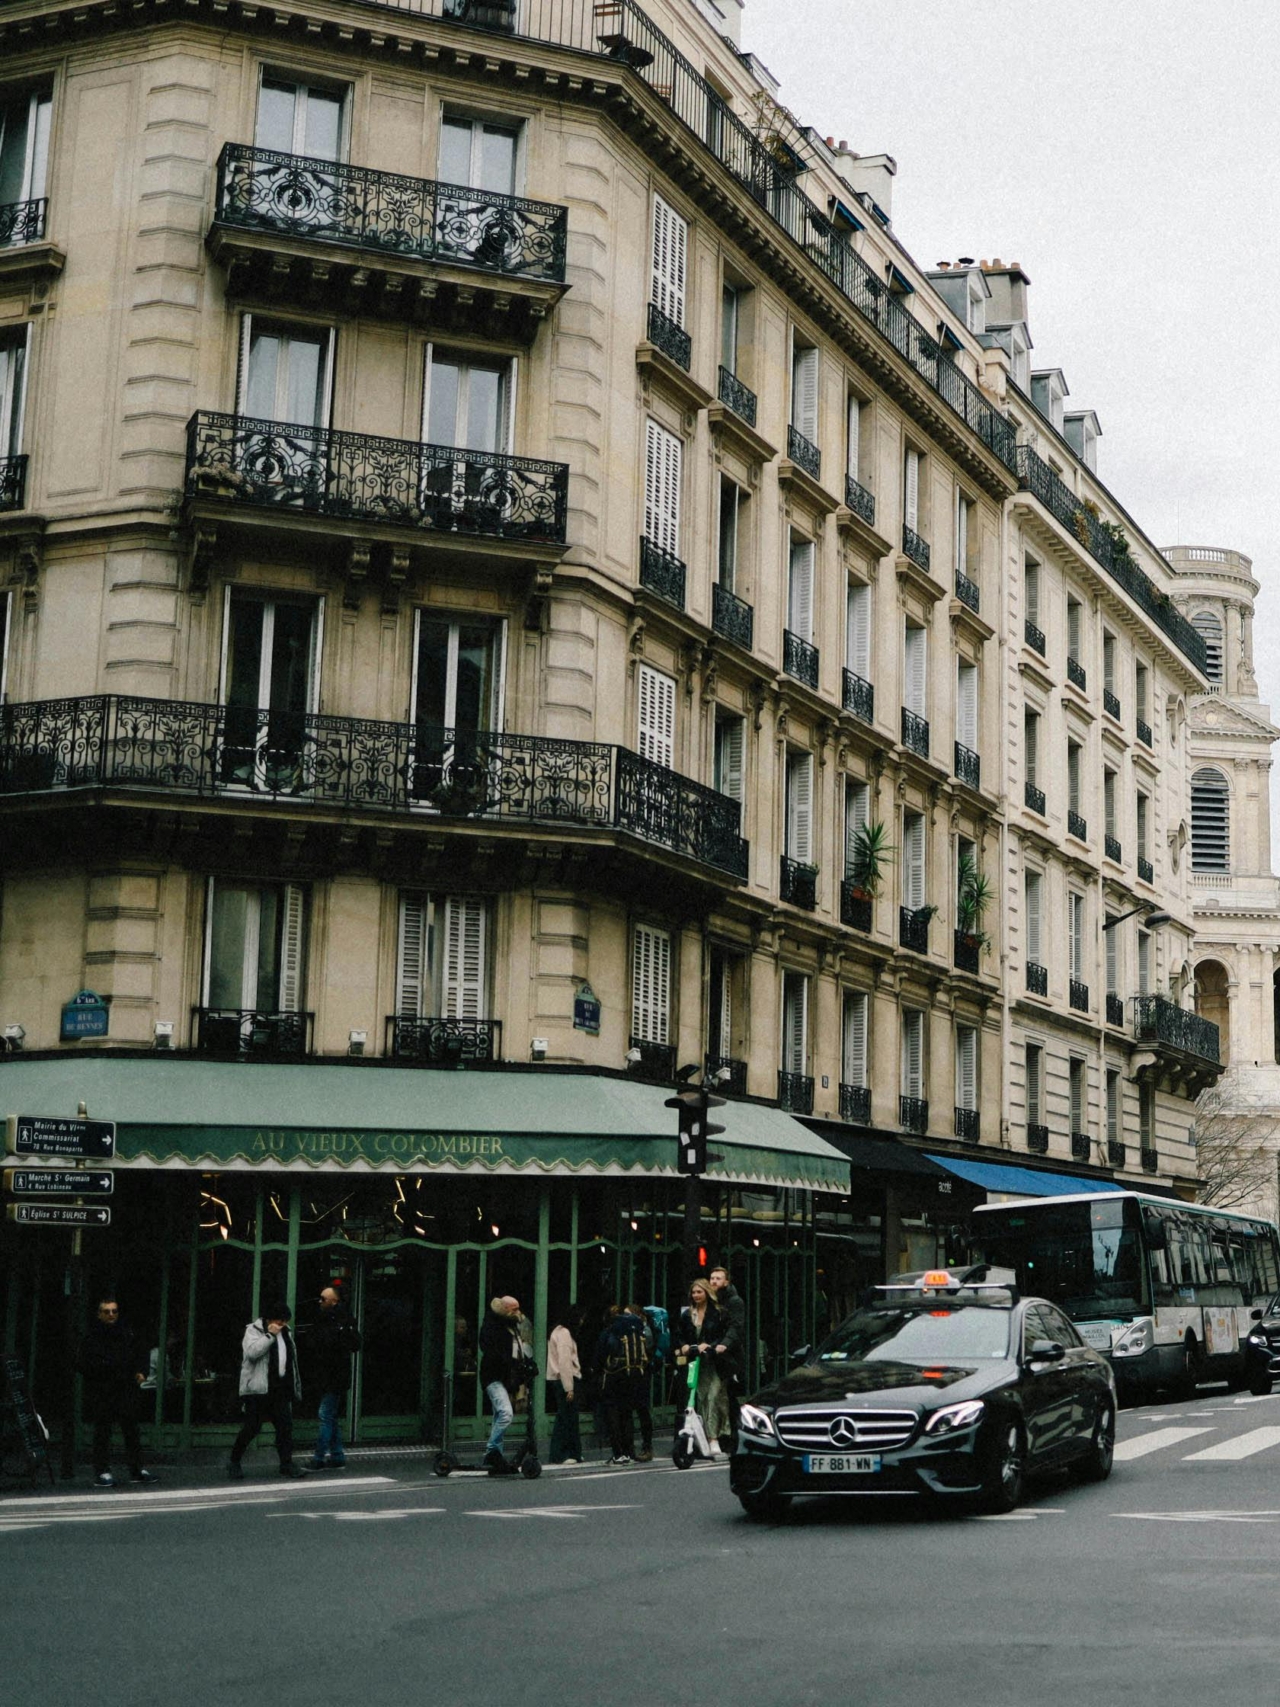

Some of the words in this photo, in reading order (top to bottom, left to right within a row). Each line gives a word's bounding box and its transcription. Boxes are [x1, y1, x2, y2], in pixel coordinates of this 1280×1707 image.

[78, 1013, 93, 1021] RUE
[77, 1022, 103, 1030] RENNES
[34, 1121, 56, 1131] Mairie
[59, 1123, 67, 1131] du
[33, 1132, 80, 1143] Commissariat
[252, 1132, 285, 1151] AU
[296, 1133, 365, 1152] VIEUX
[374, 1135, 503, 1154] COLOMBIER
[55, 1144, 83, 1153] Bonaparte
[28, 1173, 52, 1182] Marché
[64, 1174, 90, 1183] Germain
[30, 1208, 50, 1219] Église
[62, 1211, 87, 1220] SULPICE
